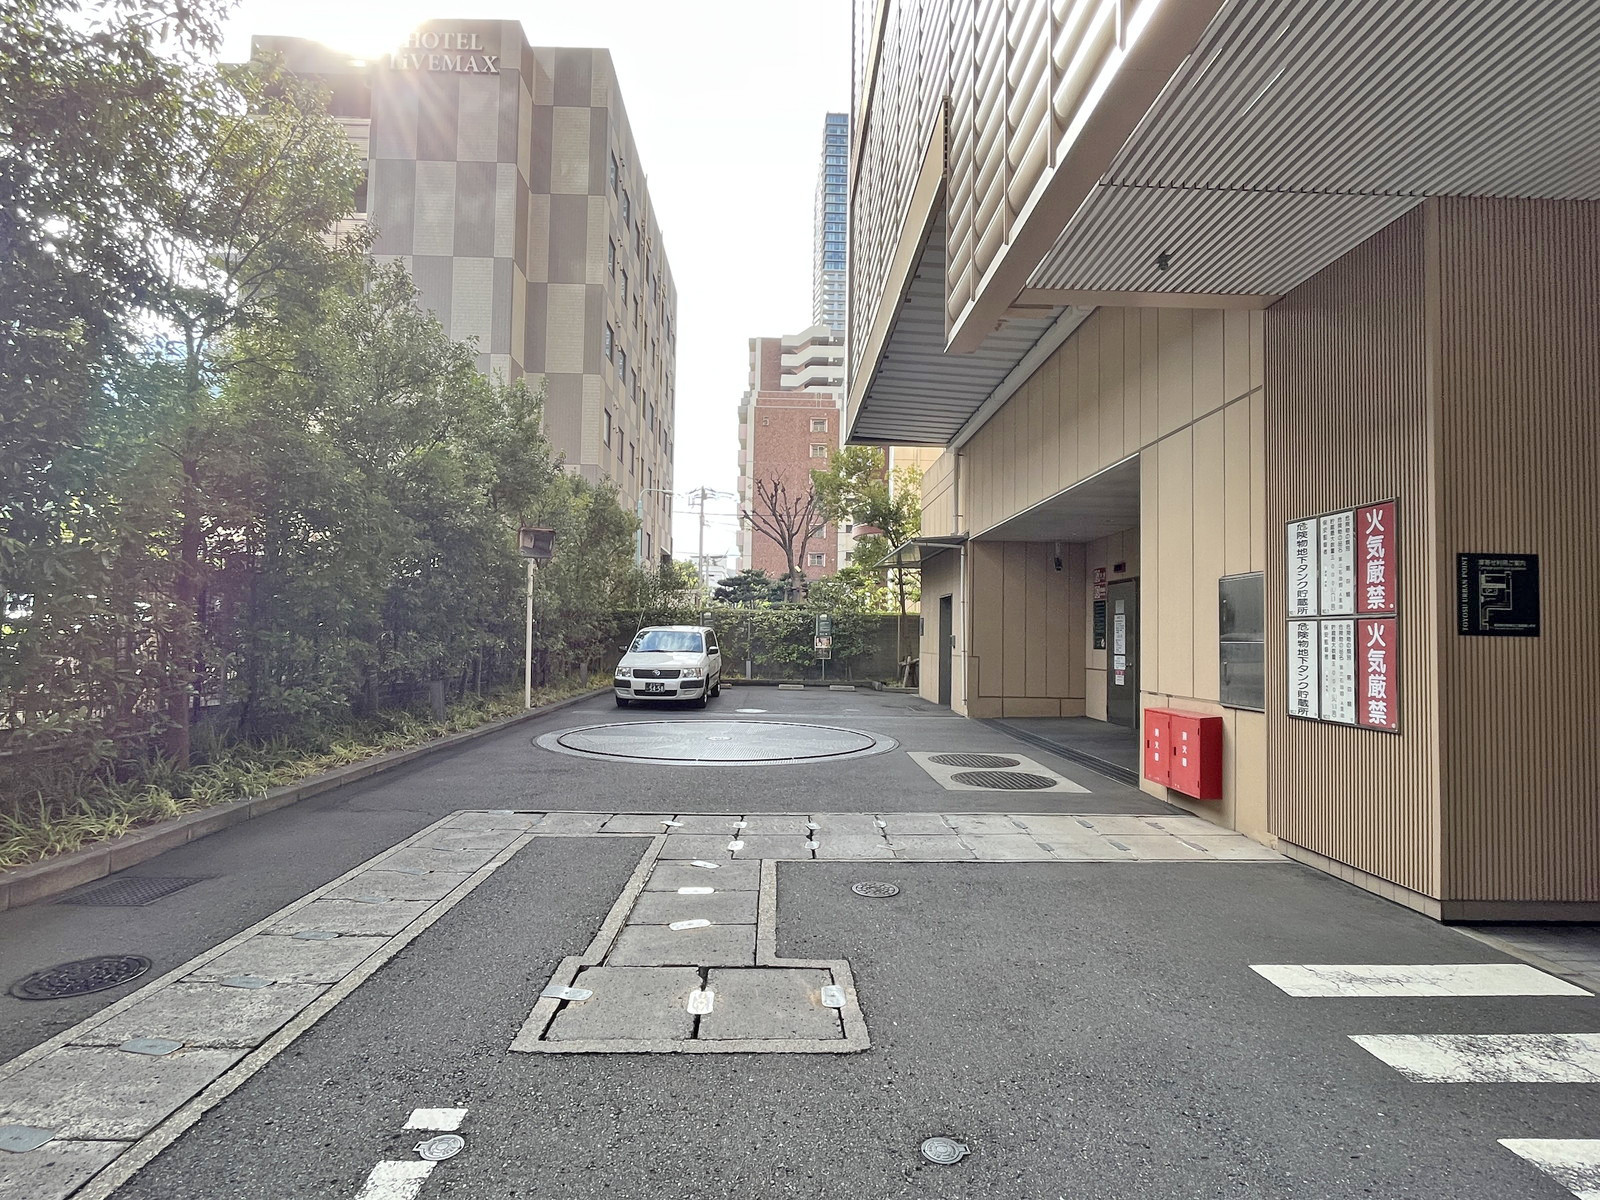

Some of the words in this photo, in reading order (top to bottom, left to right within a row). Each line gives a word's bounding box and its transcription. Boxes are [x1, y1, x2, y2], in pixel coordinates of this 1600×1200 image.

[401, 31, 484, 51] HOTEL
[1296, 522, 1309, 615] 危険物地下タンク貯蔵所
[1366, 509, 1386, 609] 火気厳禁
[1297, 622, 1310, 716] 危険物地下タンク貯蔵所
[1367, 622, 1387, 725] 火気厳禁
